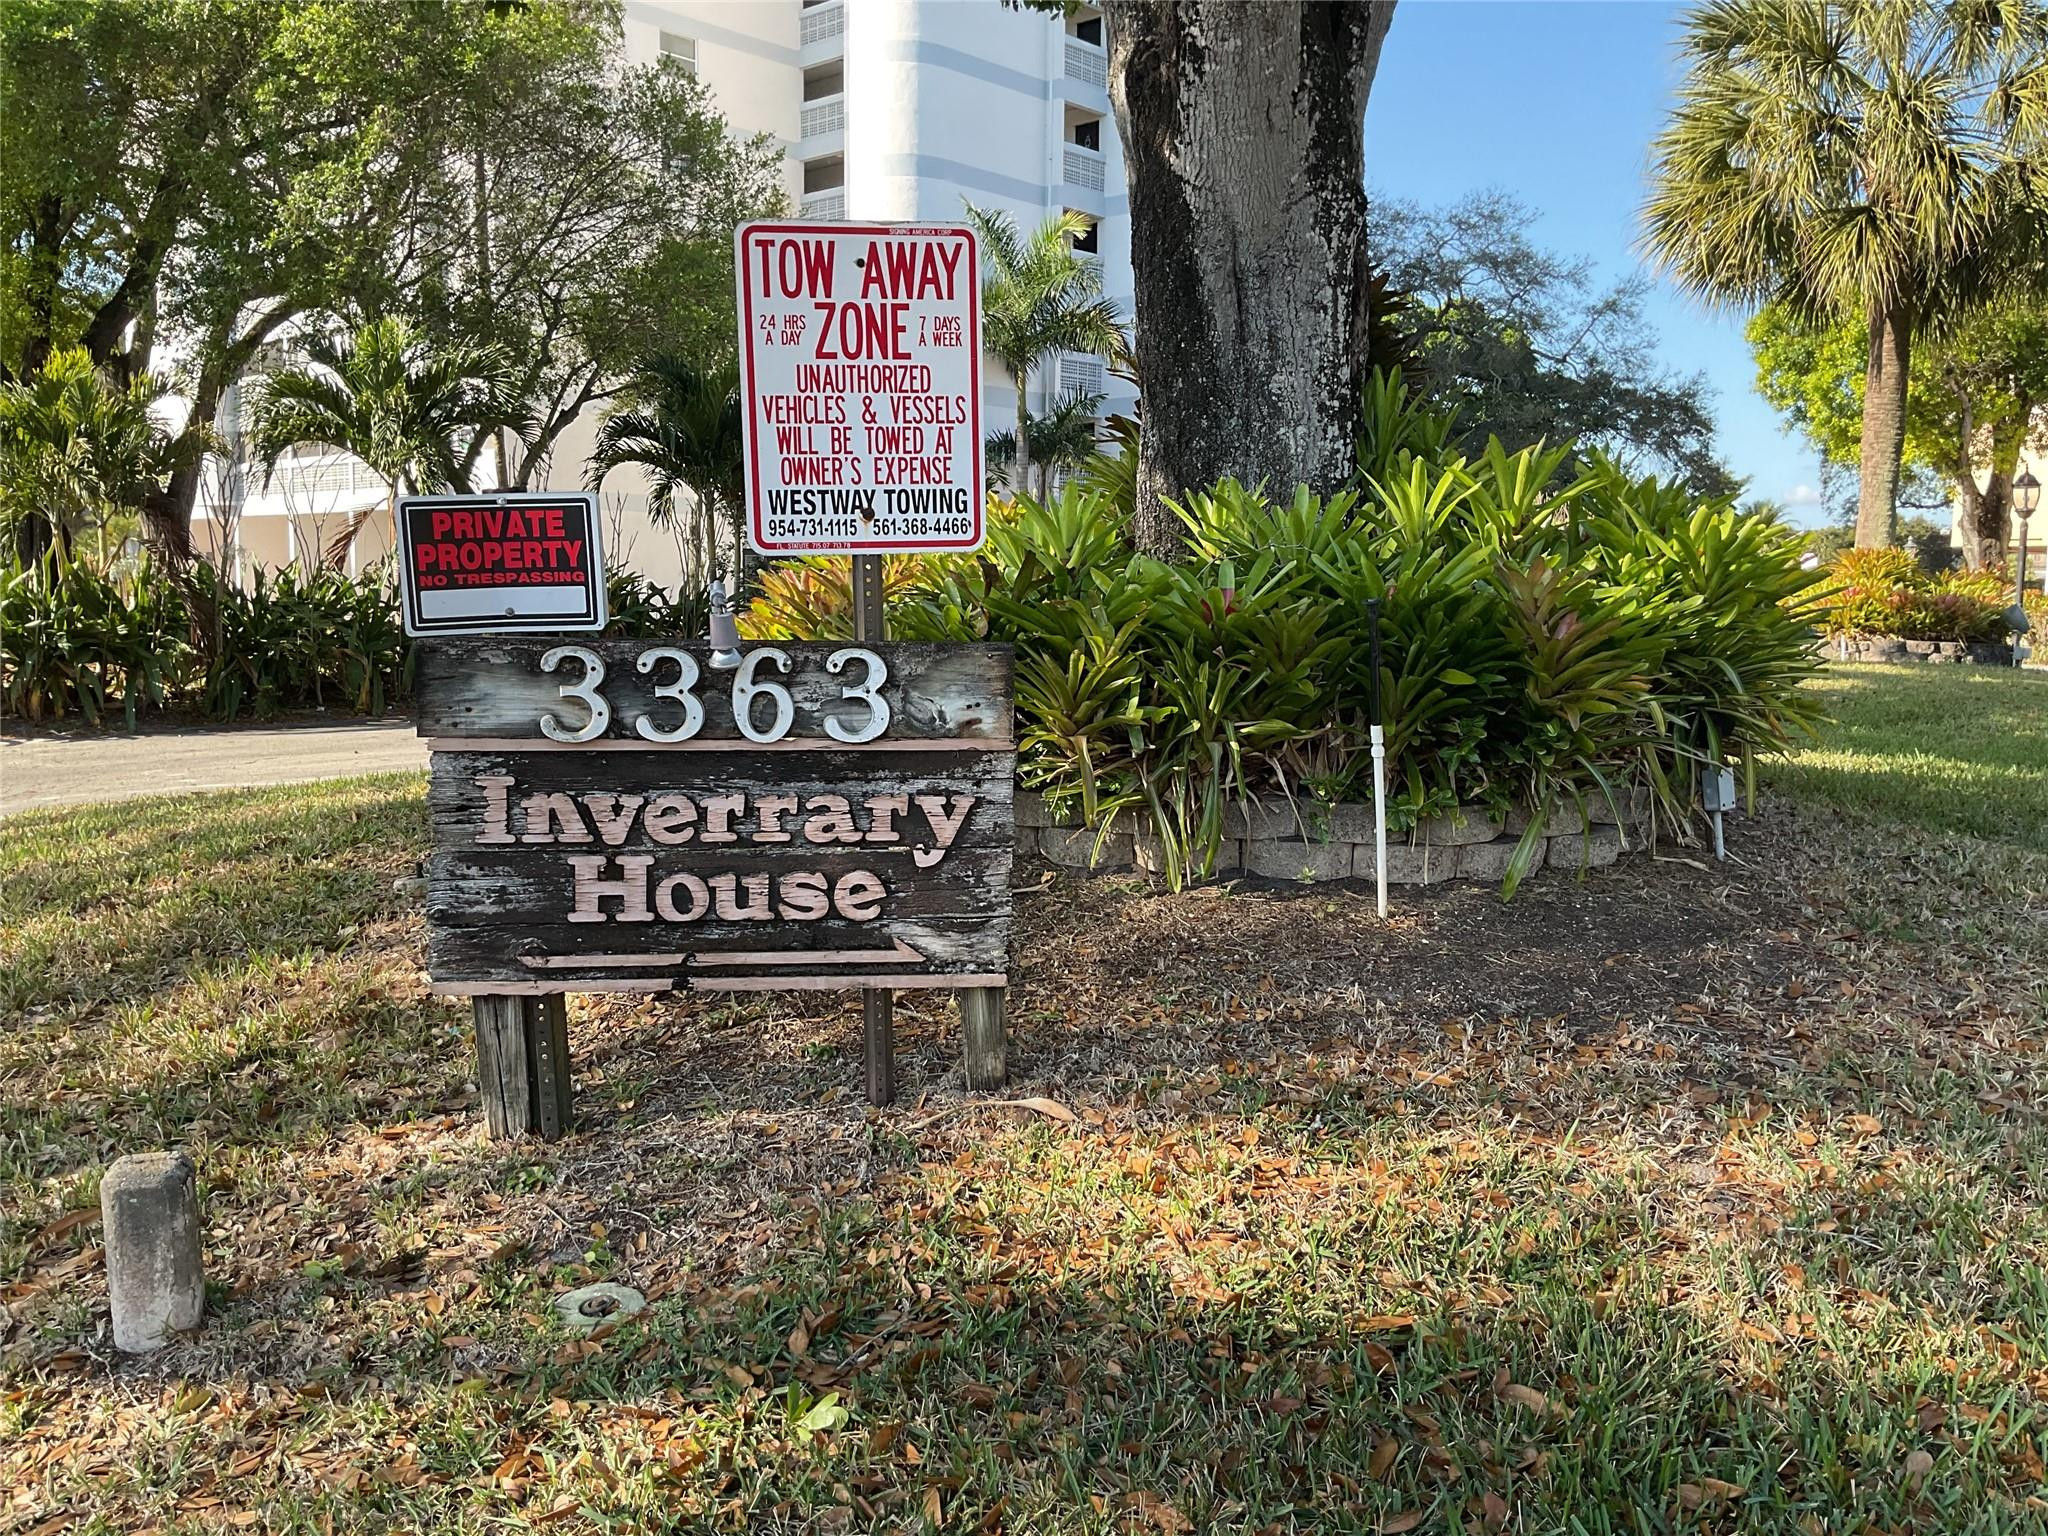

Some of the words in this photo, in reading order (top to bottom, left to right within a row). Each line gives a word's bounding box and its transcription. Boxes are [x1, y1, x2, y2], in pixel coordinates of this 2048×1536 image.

[755, 238, 836, 299] TOW
[861, 241, 963, 300] AWAY
[760, 314, 776, 330] 24
[784, 314, 806, 330] HRS
[814, 302, 912, 360] ZONE
[919, 316, 927, 331] 7
[934, 316, 961, 332] DAYS
[765, 331, 774, 345] A
[781, 331, 802, 346] DAY
[918, 332, 927, 347] A
[933, 332, 962, 347] WEEK
[796, 364, 931, 394] UNAUTHORIZED
[762, 395, 846, 424] VEHICLES
[862, 395, 877, 424] &
[890, 395, 966, 424] VESSELS
[776, 426, 819, 455] WILL
[831, 426, 853, 455] BE
[865, 426, 924, 455] TOWED
[935, 426, 954, 455] AT
[781, 457, 862, 486] OWNER'S
[874, 456, 953, 485] EXPENSE
[768, 488, 876, 516] WESTWAY
[884, 488, 968, 514] TOWING
[431, 510, 565, 540] PRIVATE
[769, 519, 857, 537] 954-731-1115
[873, 517, 968, 536] 561-368-4466
[416, 540, 582, 571] PROPERTY
[419, 574, 448, 587] NO
[454, 571, 586, 585] TRESPASSING
[539, 646, 890, 743] 3363
[474, 774, 976, 868] Inverrary
[567, 855, 888, 923] House
